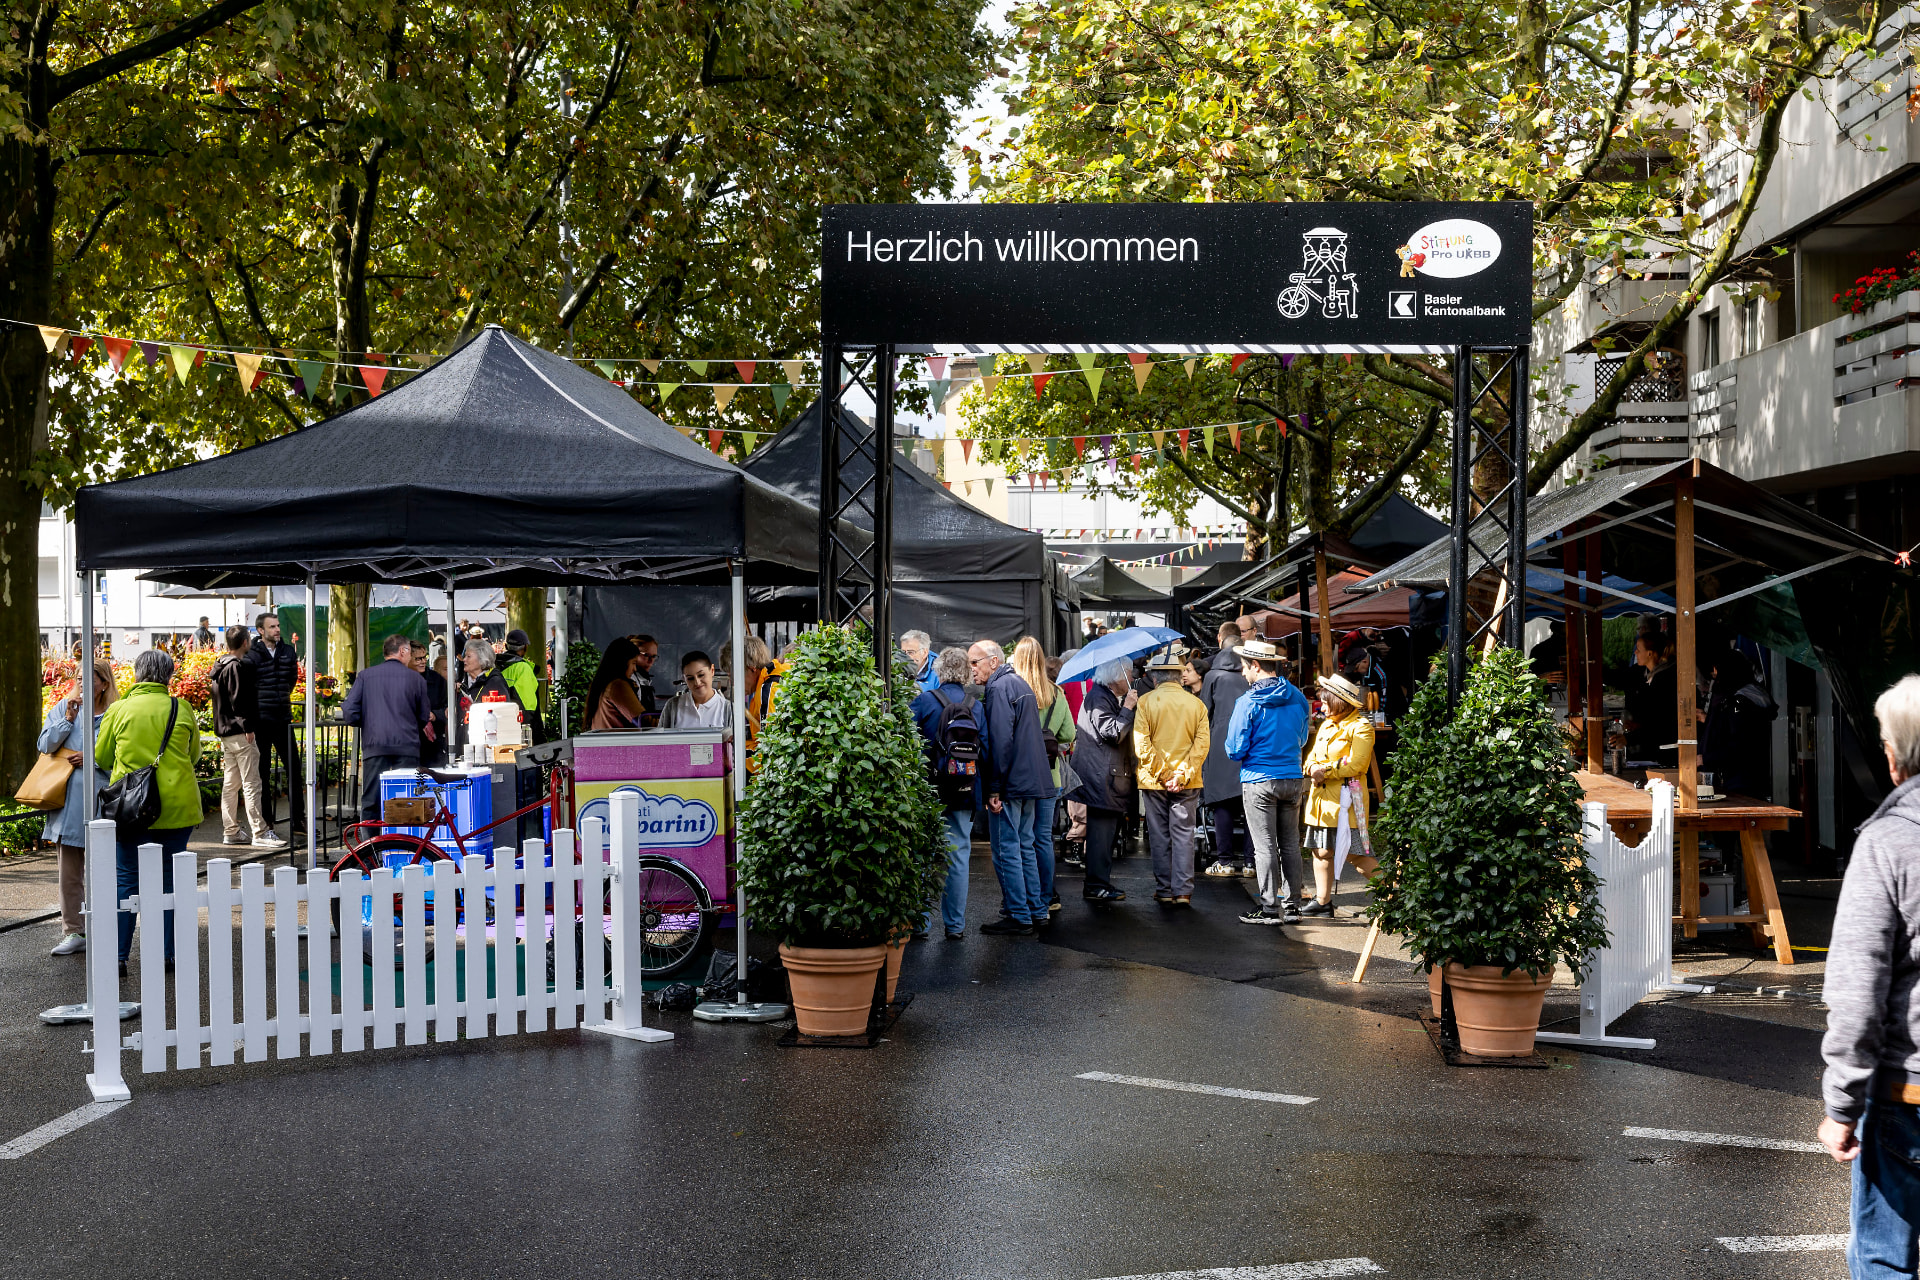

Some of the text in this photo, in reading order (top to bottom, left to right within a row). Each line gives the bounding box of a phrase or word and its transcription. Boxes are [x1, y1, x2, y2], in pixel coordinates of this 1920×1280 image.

[848, 231, 1199, 262] Herzlich willkommen
[1457, 248, 1491, 259] UKBB
[1424, 294, 1463, 304] Basler
[1424, 305, 1506, 316] Kantonalbank
